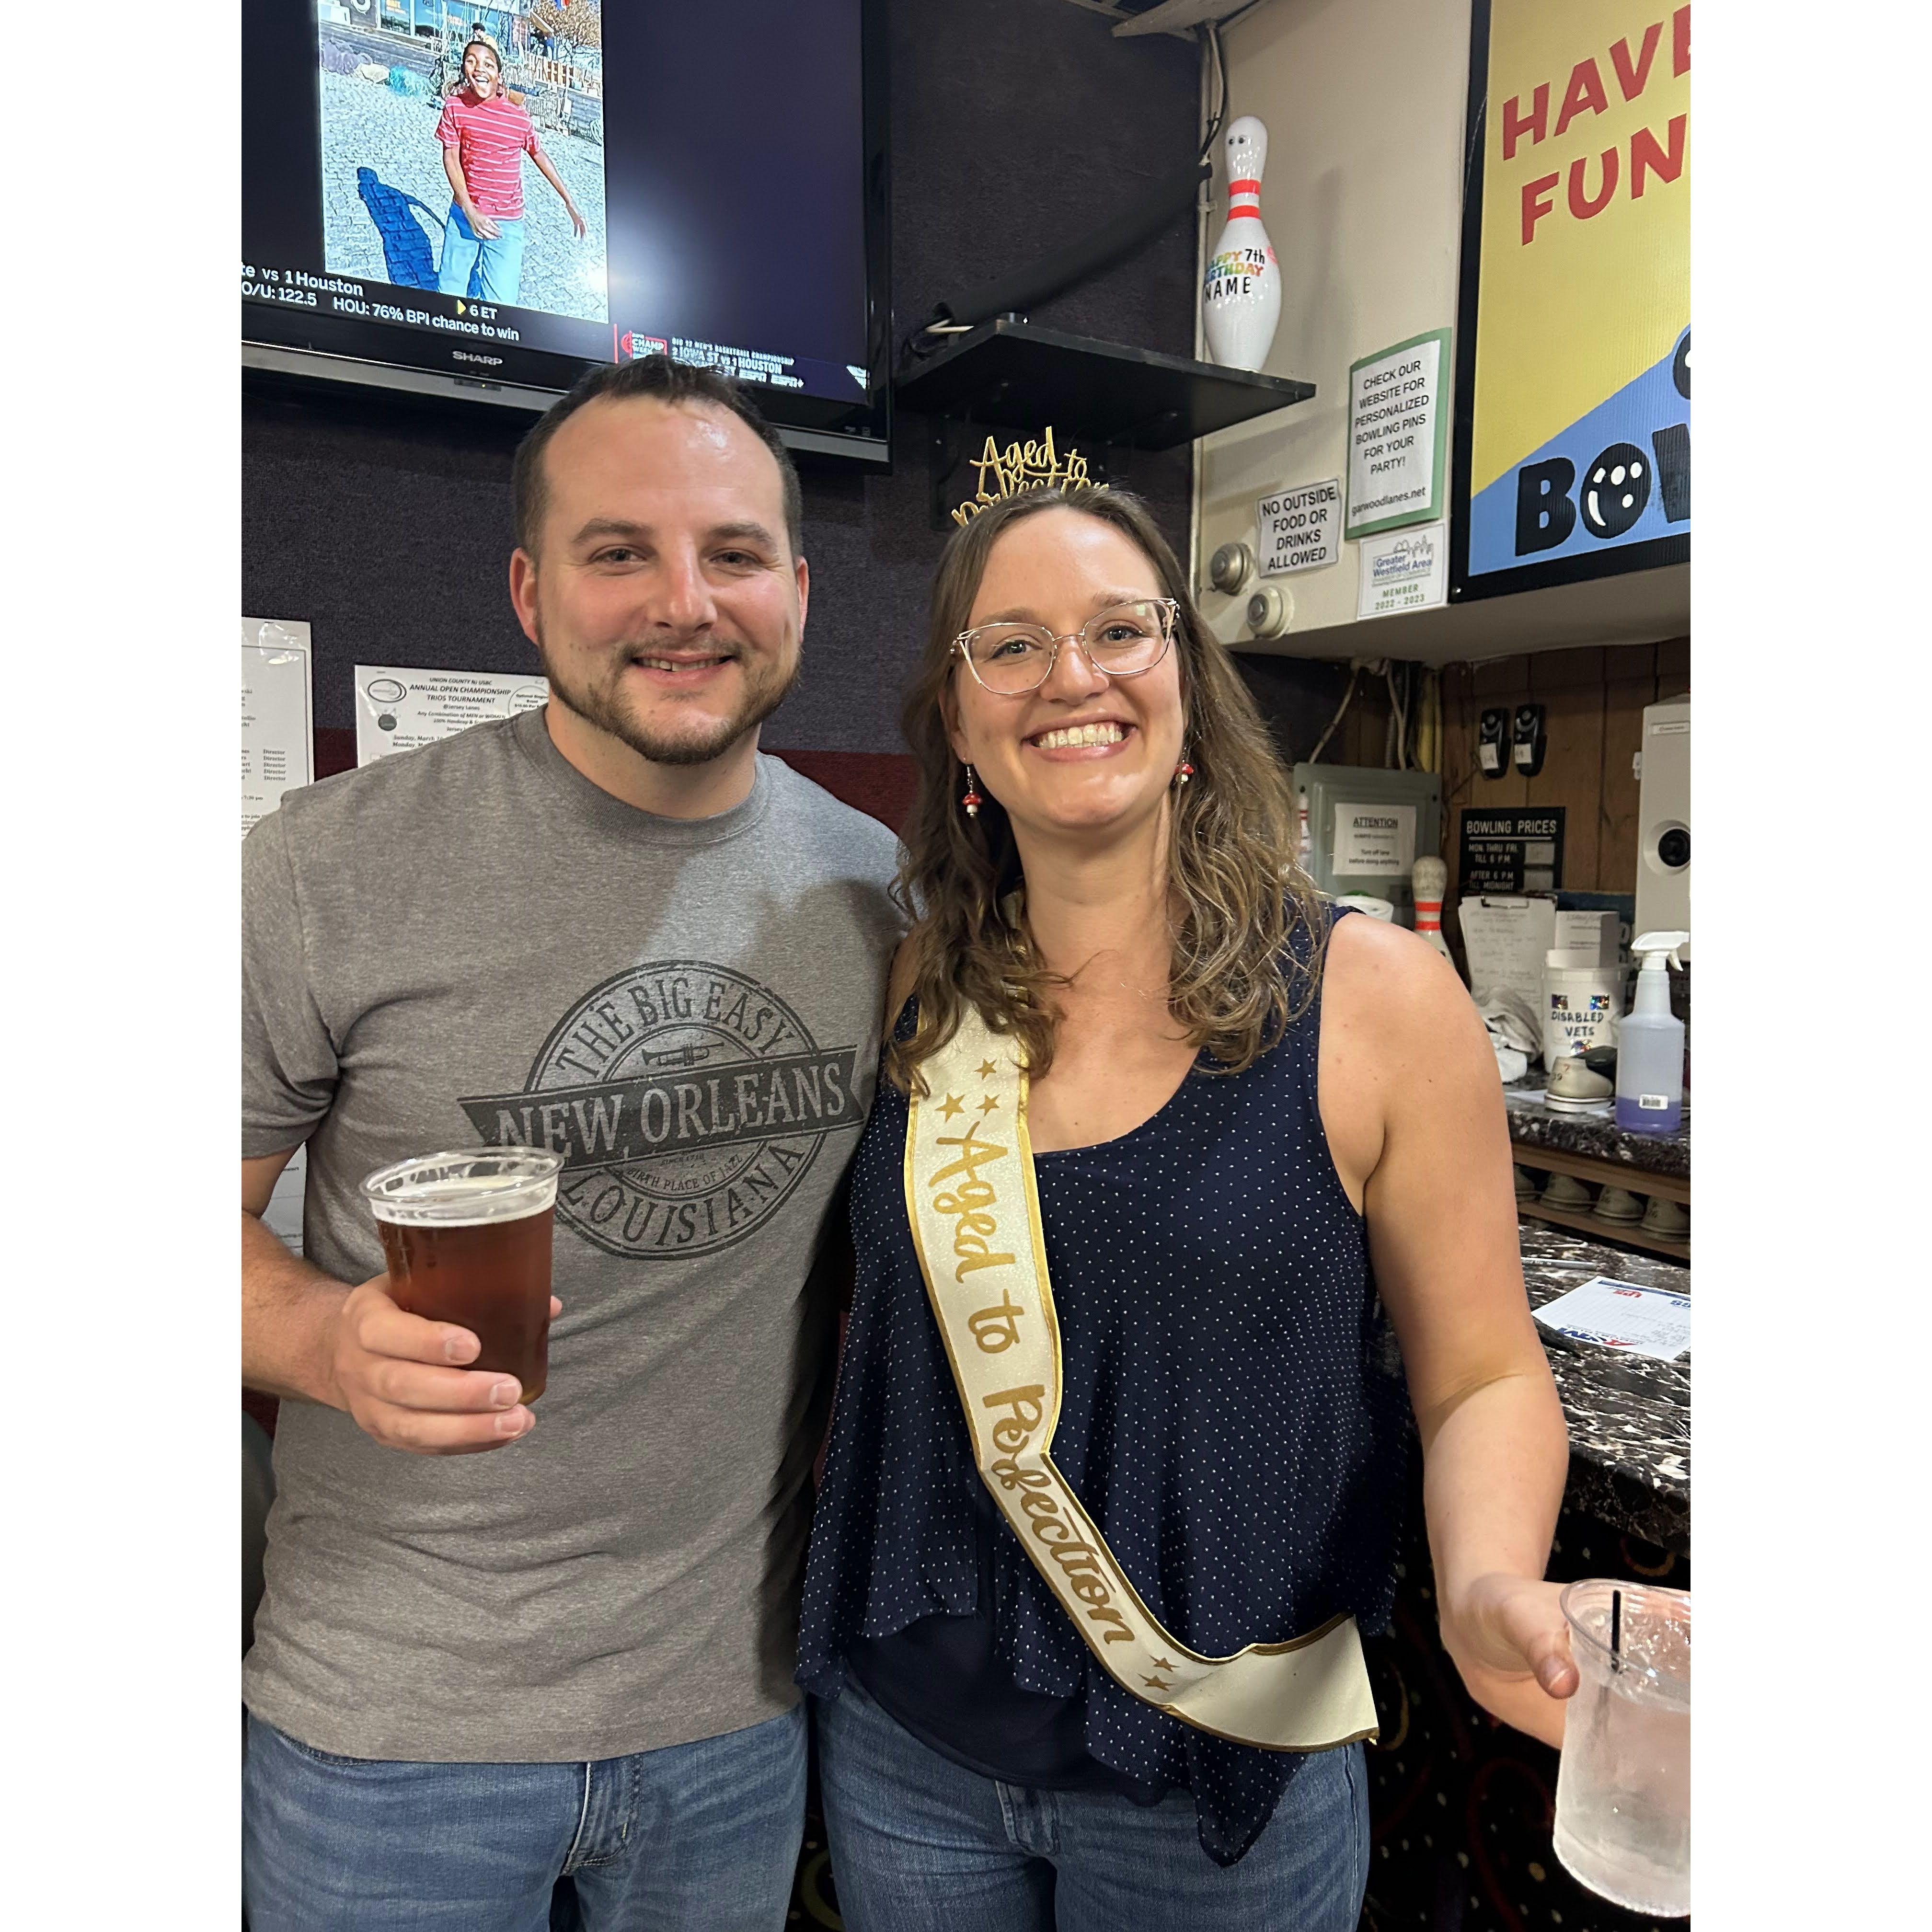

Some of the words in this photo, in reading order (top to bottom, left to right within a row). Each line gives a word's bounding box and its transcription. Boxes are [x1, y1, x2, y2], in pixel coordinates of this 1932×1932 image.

[1522, 113, 1687, 246] FUN
[1245, 249, 1265, 264] 7th
[262, 268, 279, 281] vs
[285, 270, 293, 284] 1
[295, 271, 363, 296] Houston
[1204, 276, 1251, 303] NAME
[242, 281, 276, 299] O/U:
[278, 288, 317, 307] 122.5
[333, 296, 370, 315] HOU:
[372, 303, 404, 321] 76%
[407, 309, 430, 325] BPI
[432, 314, 479, 334] chance
[481, 322, 495, 337] to
[497, 327, 519, 341] win
[469, 304, 479, 317] 6
[481, 306, 497, 320] ET
[632, 338, 664, 351] CHAMP
[452, 351, 503, 366] SHARP
[672, 346, 678, 356] 2
[679, 346, 705, 361] IOWA
[707, 351, 719, 363] ST
[732, 357, 737, 367] 1
[738, 356, 782, 375] HOUSTON
[739, 368, 767, 382] ESPN
[1363, 368, 1396, 390] CHECK
[1399, 360, 1421, 377] OUR
[1359, 386, 1401, 410] WEBSITE
[1403, 377, 1426, 395] FOR
[1355, 394, 1429, 428] PERSONALIZED
[1356, 422, 1400, 445] BOWLING
[1403, 414, 1426, 431] PINS
[969, 426, 1061, 486] Aged
[1063, 449, 1088, 479] to
[1364, 444, 1384, 460] FOR
[1386, 436, 1414, 453] YOUR
[1370, 457, 1405, 475] PARTY!
[1262, 501, 1280, 517] NO
[1283, 486, 1336, 510] OUTSIDE
[1351, 486, 1426, 517] garwoodlanes.net
[1273, 514, 1306, 533] FOOD
[1310, 508, 1328, 525] OR
[1276, 529, 1321, 551] DRINKS
[1267, 546, 1327, 571] ALLOWED
[1373, 562, 1411, 577] Westfield
[1412, 559, 1432, 569] Area
[1376, 555, 1406, 567] Greater
[1375, 599, 1394, 610] 2022
[1403, 593, 1425, 605] 2023
[1383, 583, 1418, 598] MEMBER
[448, 695, 495, 703] TOURNAMENT
[460, 687, 511, 695] CHAMPIONSHIP
[1353, 817, 1398, 828] ATTENTION
[1466, 820, 1511, 834] BOWLING
[1518, 820, 1557, 834] PRICES
[1470, 871, 1490, 880] AFTER
[1483, 881, 1514, 890] MIDNIGHT
[555, 1002, 634, 1079] THE
[629, 977, 693, 1027] BIG
[706, 980, 796, 1055] EASY
[1552, 1011, 1604, 1024] DISABLED
[1565, 1026, 1595, 1037] VETS
[496, 1094, 625, 1158] NEW
[640, 1062, 846, 1143] ORLEANS
[627, 1168, 659, 1187] BIRTH
[663, 1180, 700, 1191] PLACE
[703, 1172, 717, 1185] OF
[721, 1154, 743, 1180] JAZZ
[561, 1145, 805, 1246] LOUISIANA
[928, 1121, 1016, 1284] Aged
[968, 1288, 1024, 1354] to
[982, 1384, 1135, 1645] Perfection
